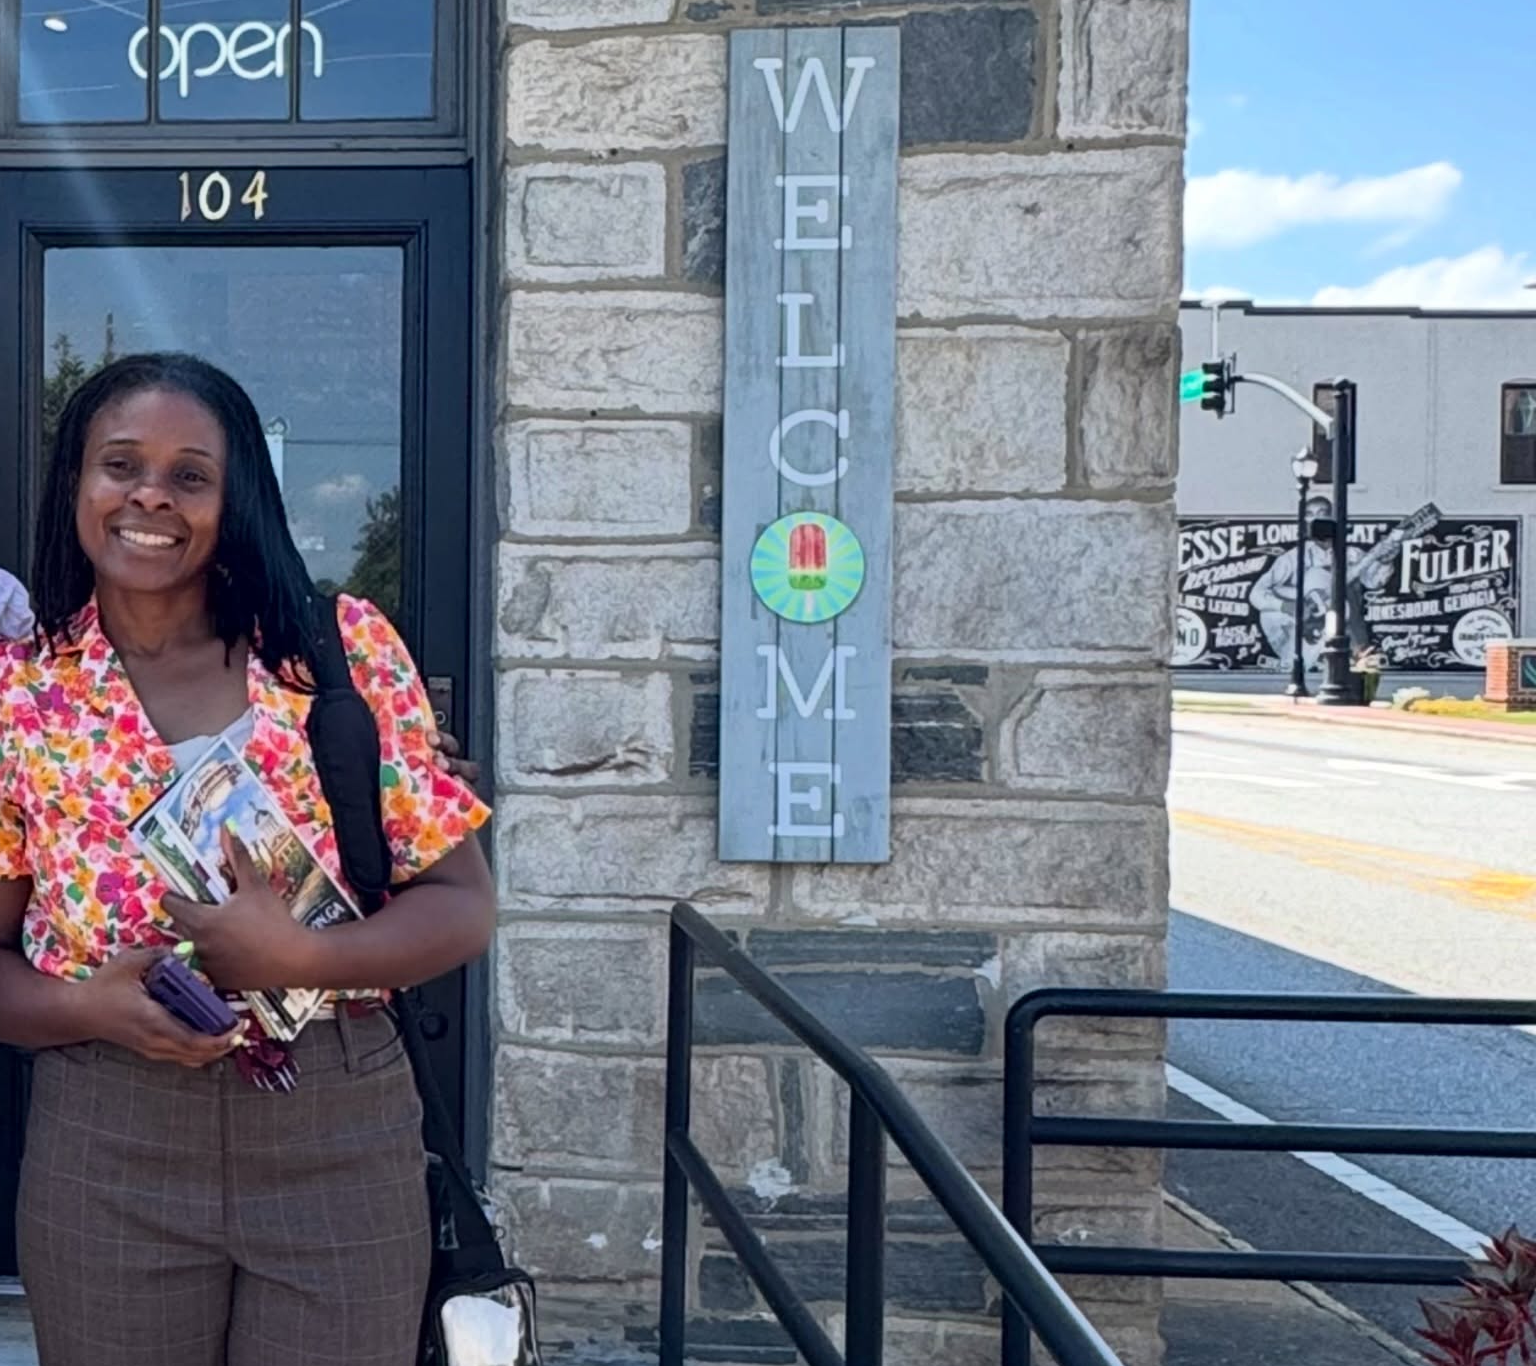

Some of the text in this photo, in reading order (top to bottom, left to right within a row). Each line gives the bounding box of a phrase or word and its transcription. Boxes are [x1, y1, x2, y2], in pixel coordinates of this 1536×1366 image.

[128, 20, 323, 98] open
[177, 171, 268, 222] 104
[1177, 525, 1246, 572] ESSE
[1399, 529, 1511, 594] FULLER
[1444, 589, 1496, 613] GEORGIA
